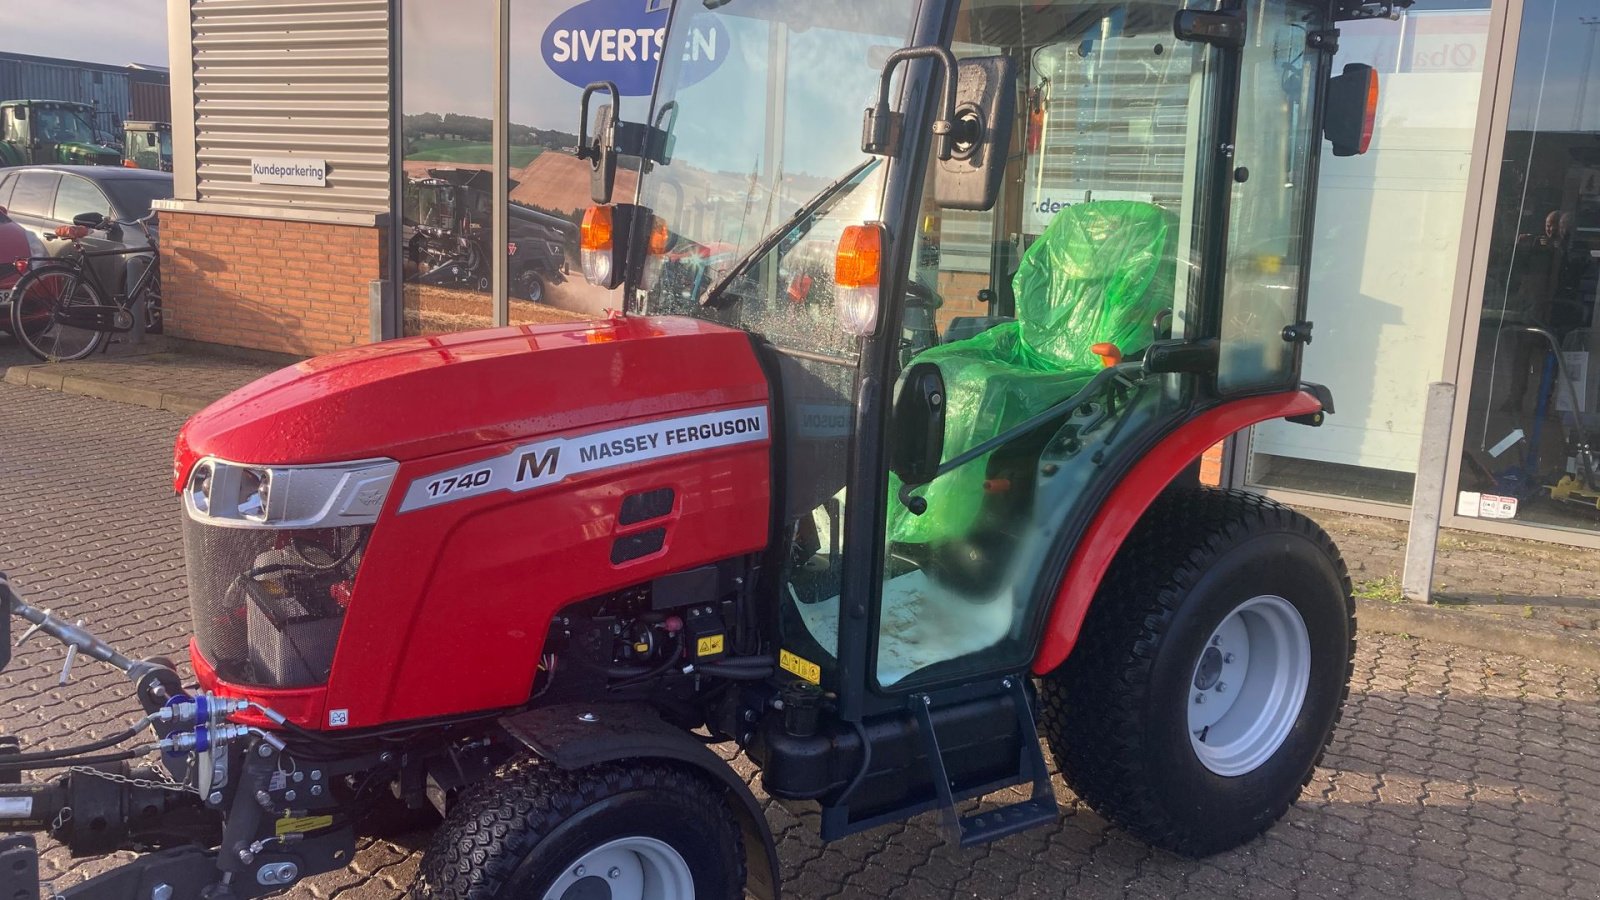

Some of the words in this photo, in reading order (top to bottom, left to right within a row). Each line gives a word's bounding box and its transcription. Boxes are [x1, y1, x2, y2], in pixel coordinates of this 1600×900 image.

[253, 163, 323, 180] Kundeparkering
[428, 469, 491, 497] 1740
[515, 446, 561, 482] M
[580, 433, 659, 463] MASSEY
[666, 416, 761, 446] FERGUSON
